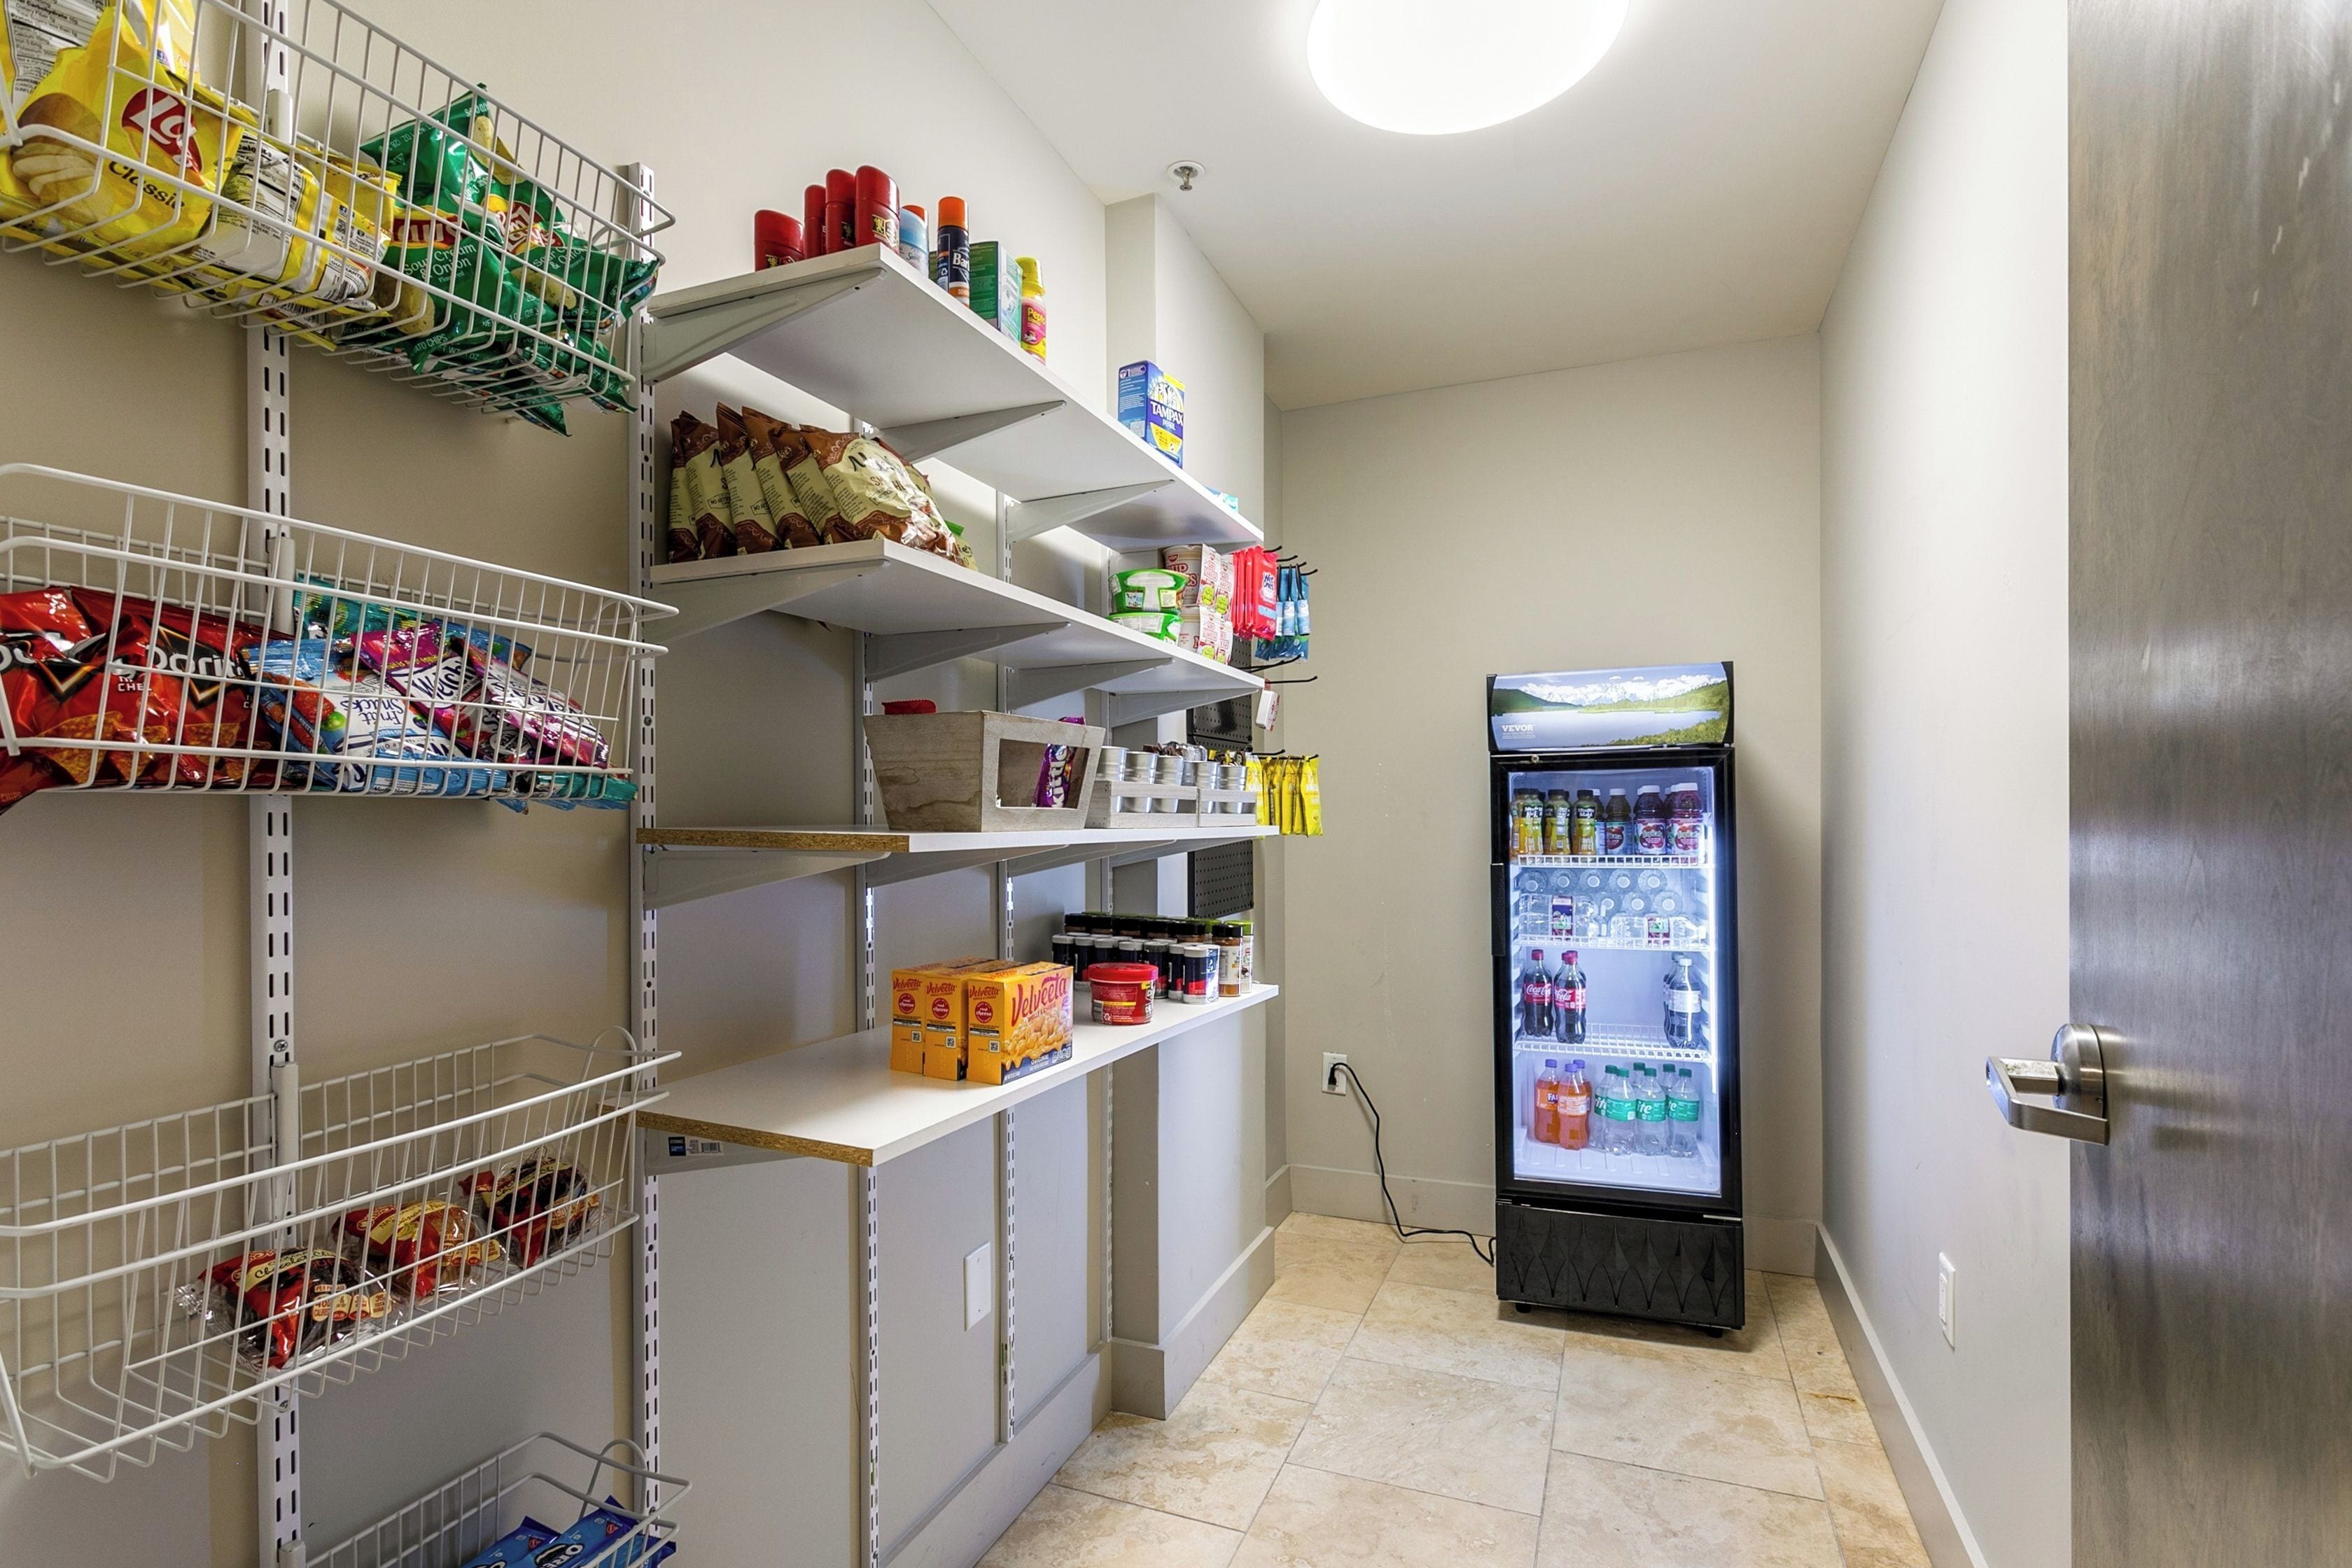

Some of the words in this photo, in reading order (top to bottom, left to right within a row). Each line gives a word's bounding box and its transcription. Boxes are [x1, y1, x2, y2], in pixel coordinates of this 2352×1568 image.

[109, 161, 185, 209] Classic
[426, 333, 448, 346] CHIPS
[1150, 400, 1184, 426] TAMPAX
[1501, 724, 1534, 733] VEVOR
[893, 977, 921, 990] Velveeta
[927, 981, 955, 995] Velveeta
[969, 985, 999, 998] Velveeta
[1011, 972, 1067, 1027] Velveeta
